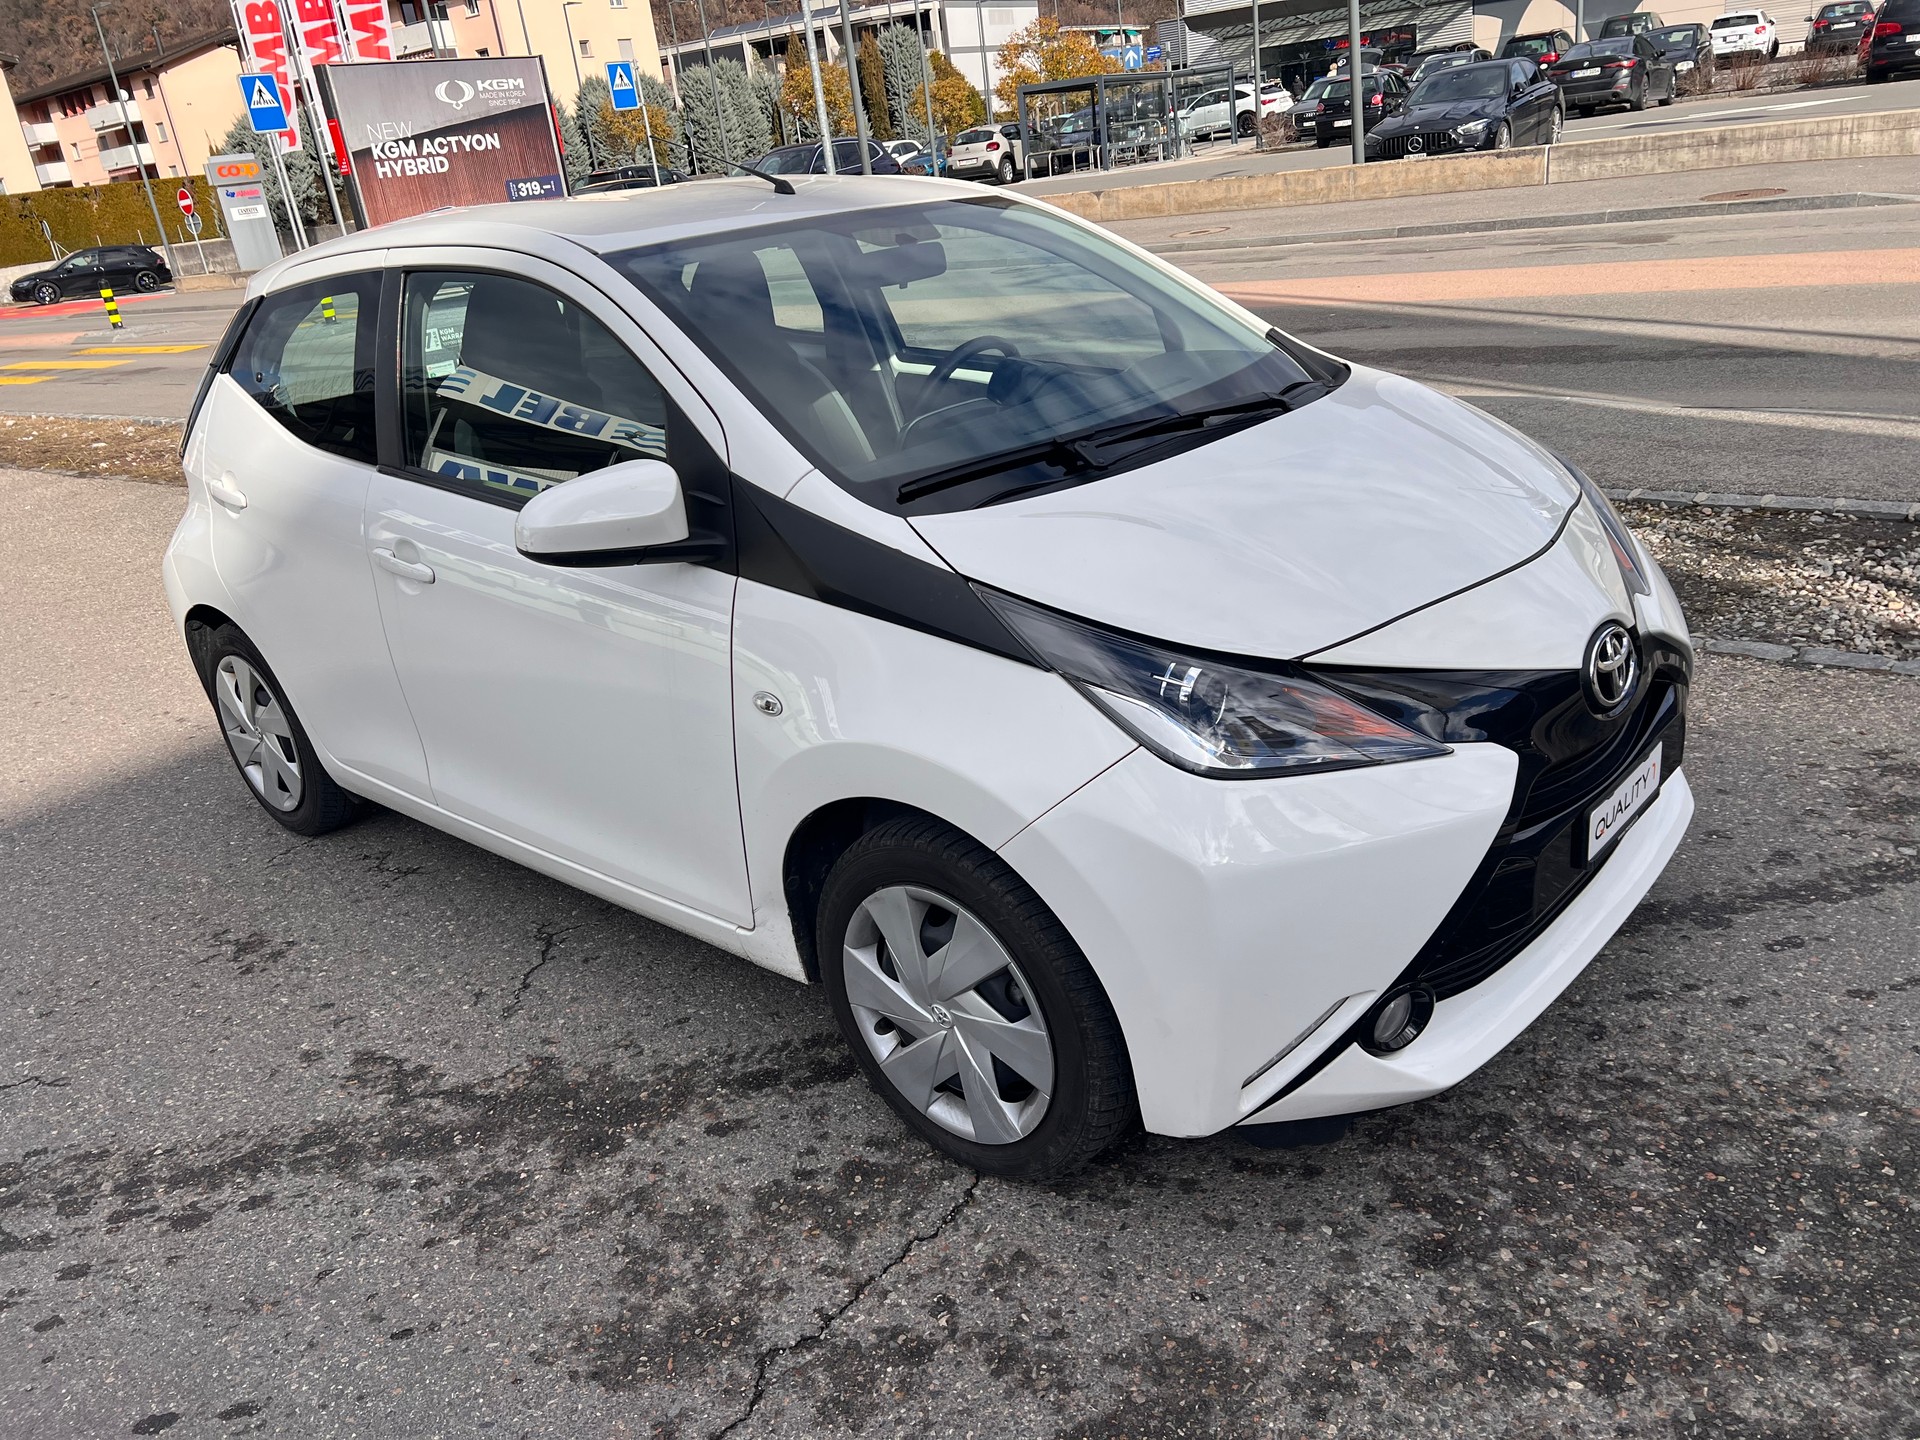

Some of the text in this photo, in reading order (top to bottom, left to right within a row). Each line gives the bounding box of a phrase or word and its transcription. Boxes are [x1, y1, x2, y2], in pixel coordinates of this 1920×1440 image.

[476, 78, 525, 91] KGM
[479, 91, 498, 99] MADE
[488, 99, 507, 107] SINCE
[366, 121, 412, 142] NEW
[371, 133, 501, 160] KGM ACTYON
[217, 162, 259, 179] coop
[377, 156, 449, 179] HYBRID
[439, 327, 454, 335] KGM
[1595, 768, 1650, 840] QUALITY
[1652, 762, 1657, 780] 1
